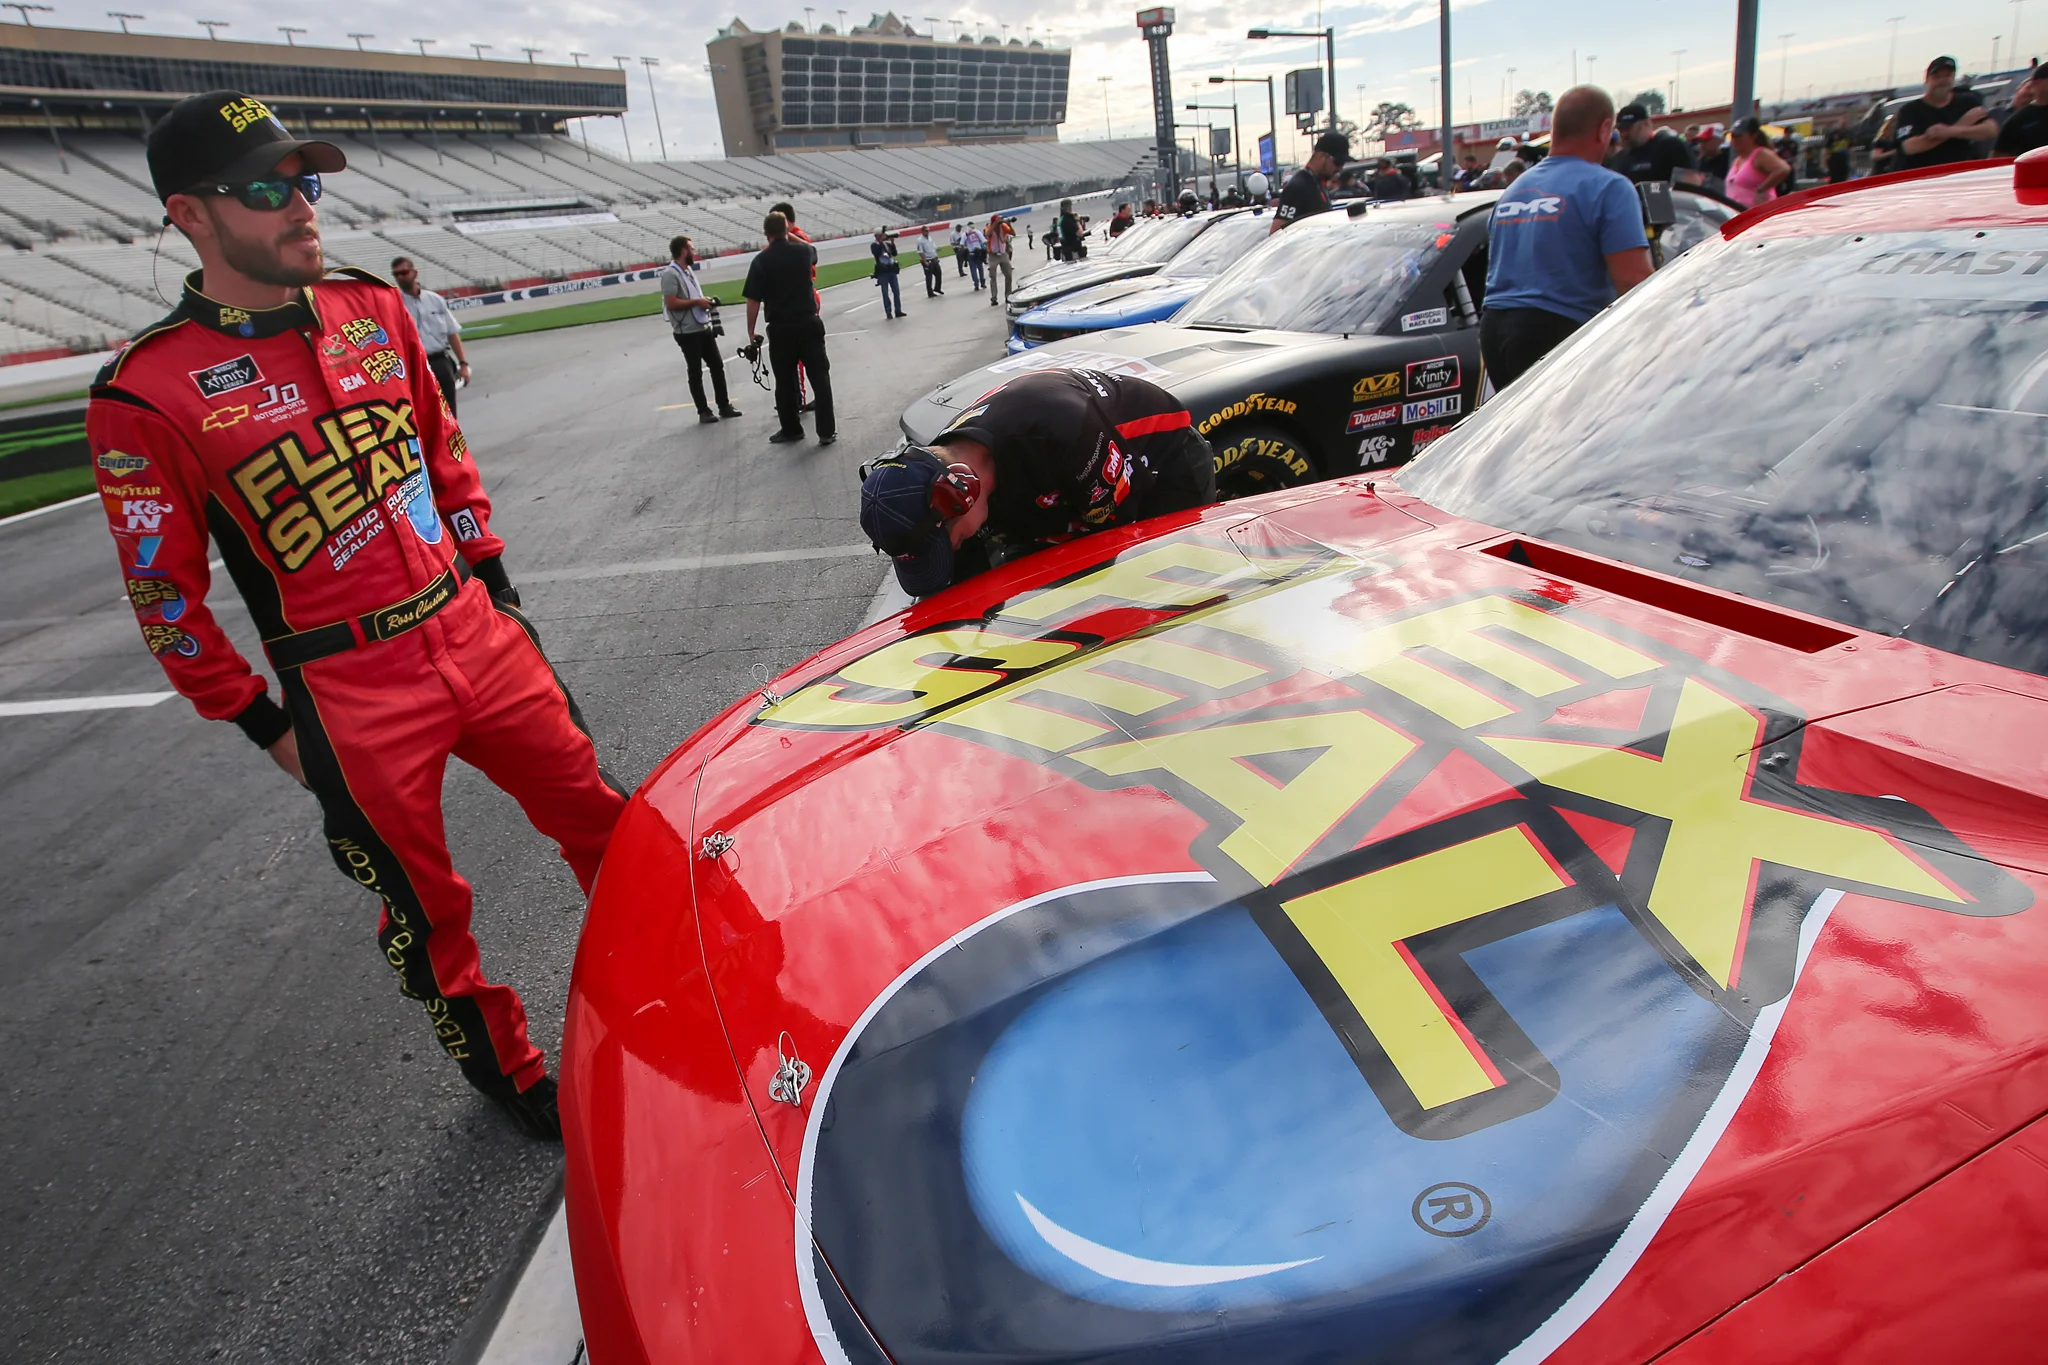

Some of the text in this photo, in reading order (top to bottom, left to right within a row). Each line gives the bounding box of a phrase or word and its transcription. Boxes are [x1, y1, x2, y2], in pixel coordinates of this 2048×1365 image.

[1280, 204, 1296, 219] 52
[549, 278, 602, 295] RESTART ZONE
[340, 317, 374, 337] FLEX
[1409, 317, 1442, 328] RACE CAR
[347, 323, 379, 346] TAPE
[361, 350, 397, 373] FLEX
[370, 357, 400, 384] SHOT
[203, 366, 250, 389] xfinity
[1415, 368, 1452, 388] xfinity
[252, 398, 307, 422] MOTORSPORTS
[1198, 393, 1297, 435] GOODYEAR
[1353, 407, 1396, 426] Duralast
[1406, 399, 1443, 420] Mobil
[99, 456, 145, 469] SUNOCO
[232, 404, 417, 520] FLEX
[267, 439, 422, 570] SEAL
[397, 483, 425, 516] COATING
[326, 473, 423, 557] LIQUID RUBBER
[386, 611, 415, 632] Ross
[999, 541, 1970, 992] FLEX
[755, 630, 1577, 1111] SEAL
